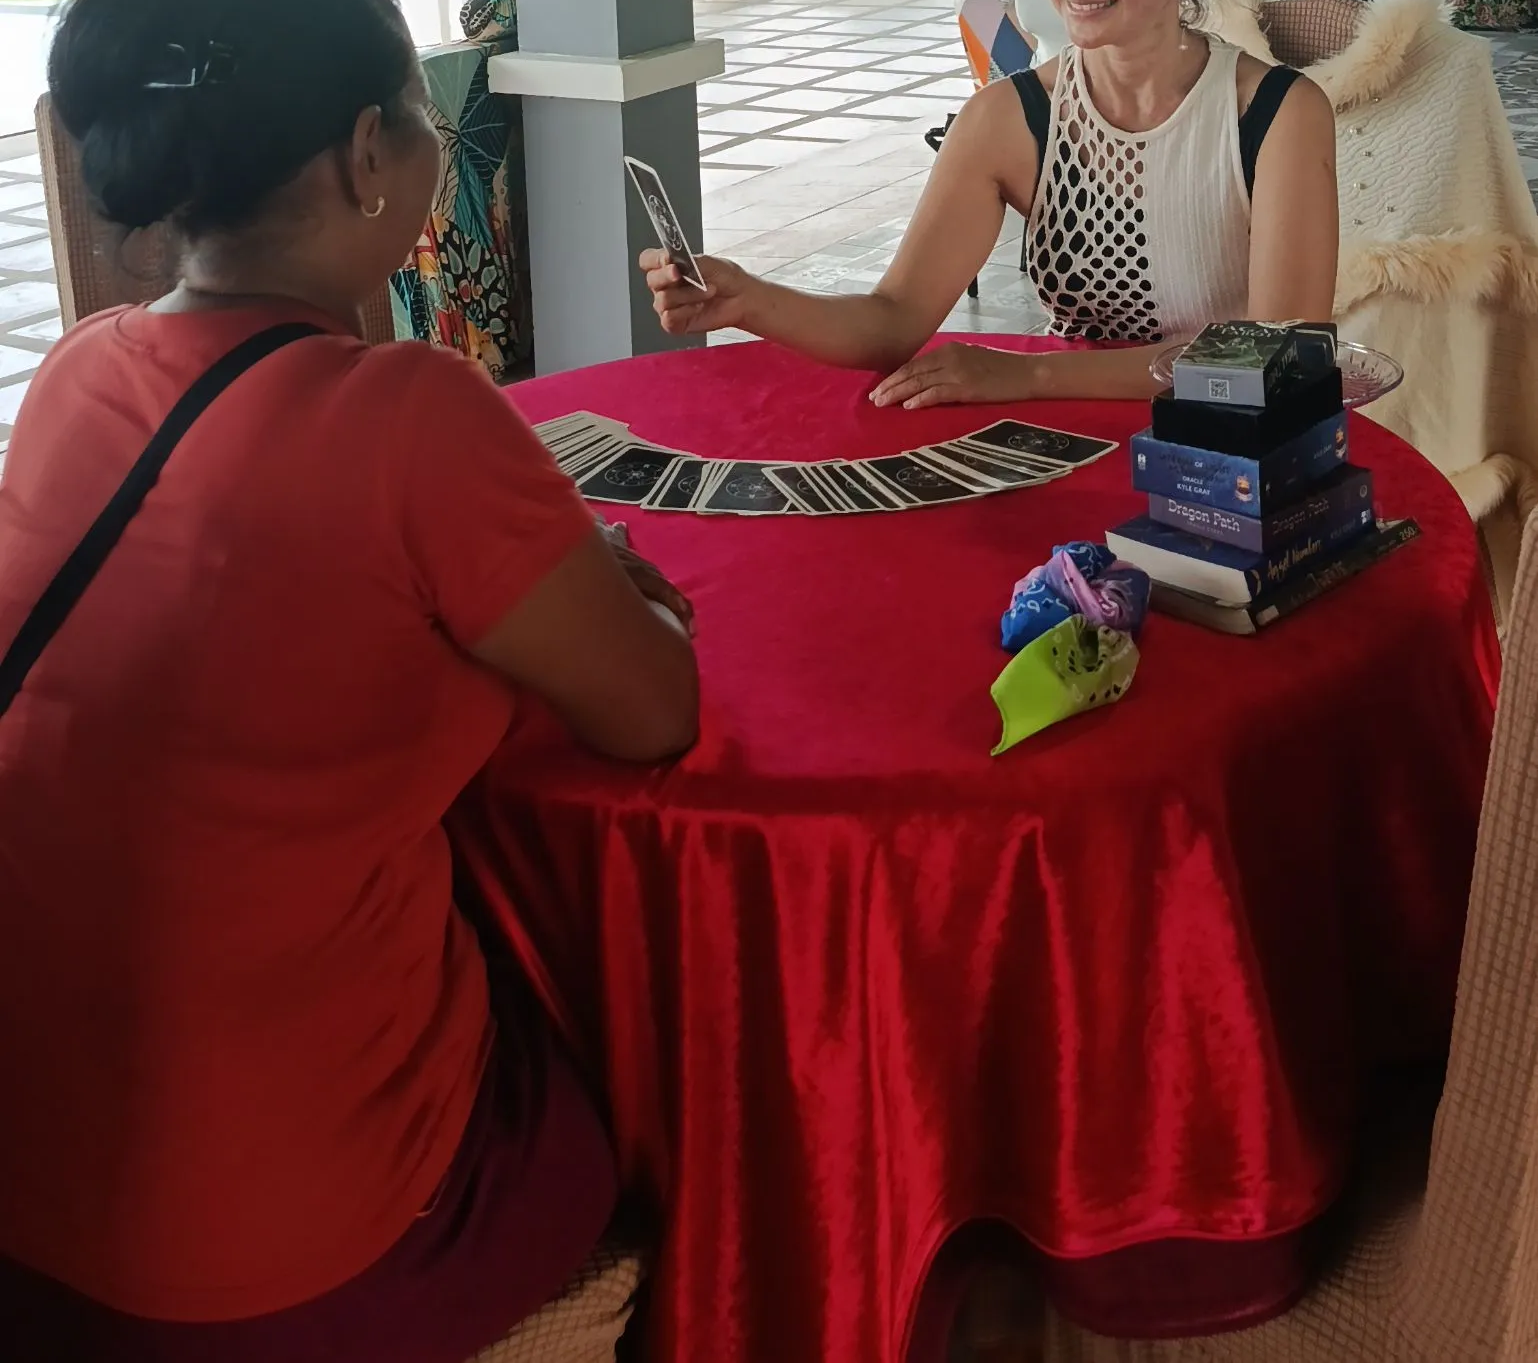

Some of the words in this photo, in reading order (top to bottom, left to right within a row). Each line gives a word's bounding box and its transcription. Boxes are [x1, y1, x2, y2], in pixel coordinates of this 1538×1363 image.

[1182, 475, 1204, 485] ORACLE
[1176, 483, 1192, 492] KYLE
[1193, 486, 1211, 496] GRAY
[1167, 498, 1210, 524] Dragon
[1213, 512, 1241, 533] Path
